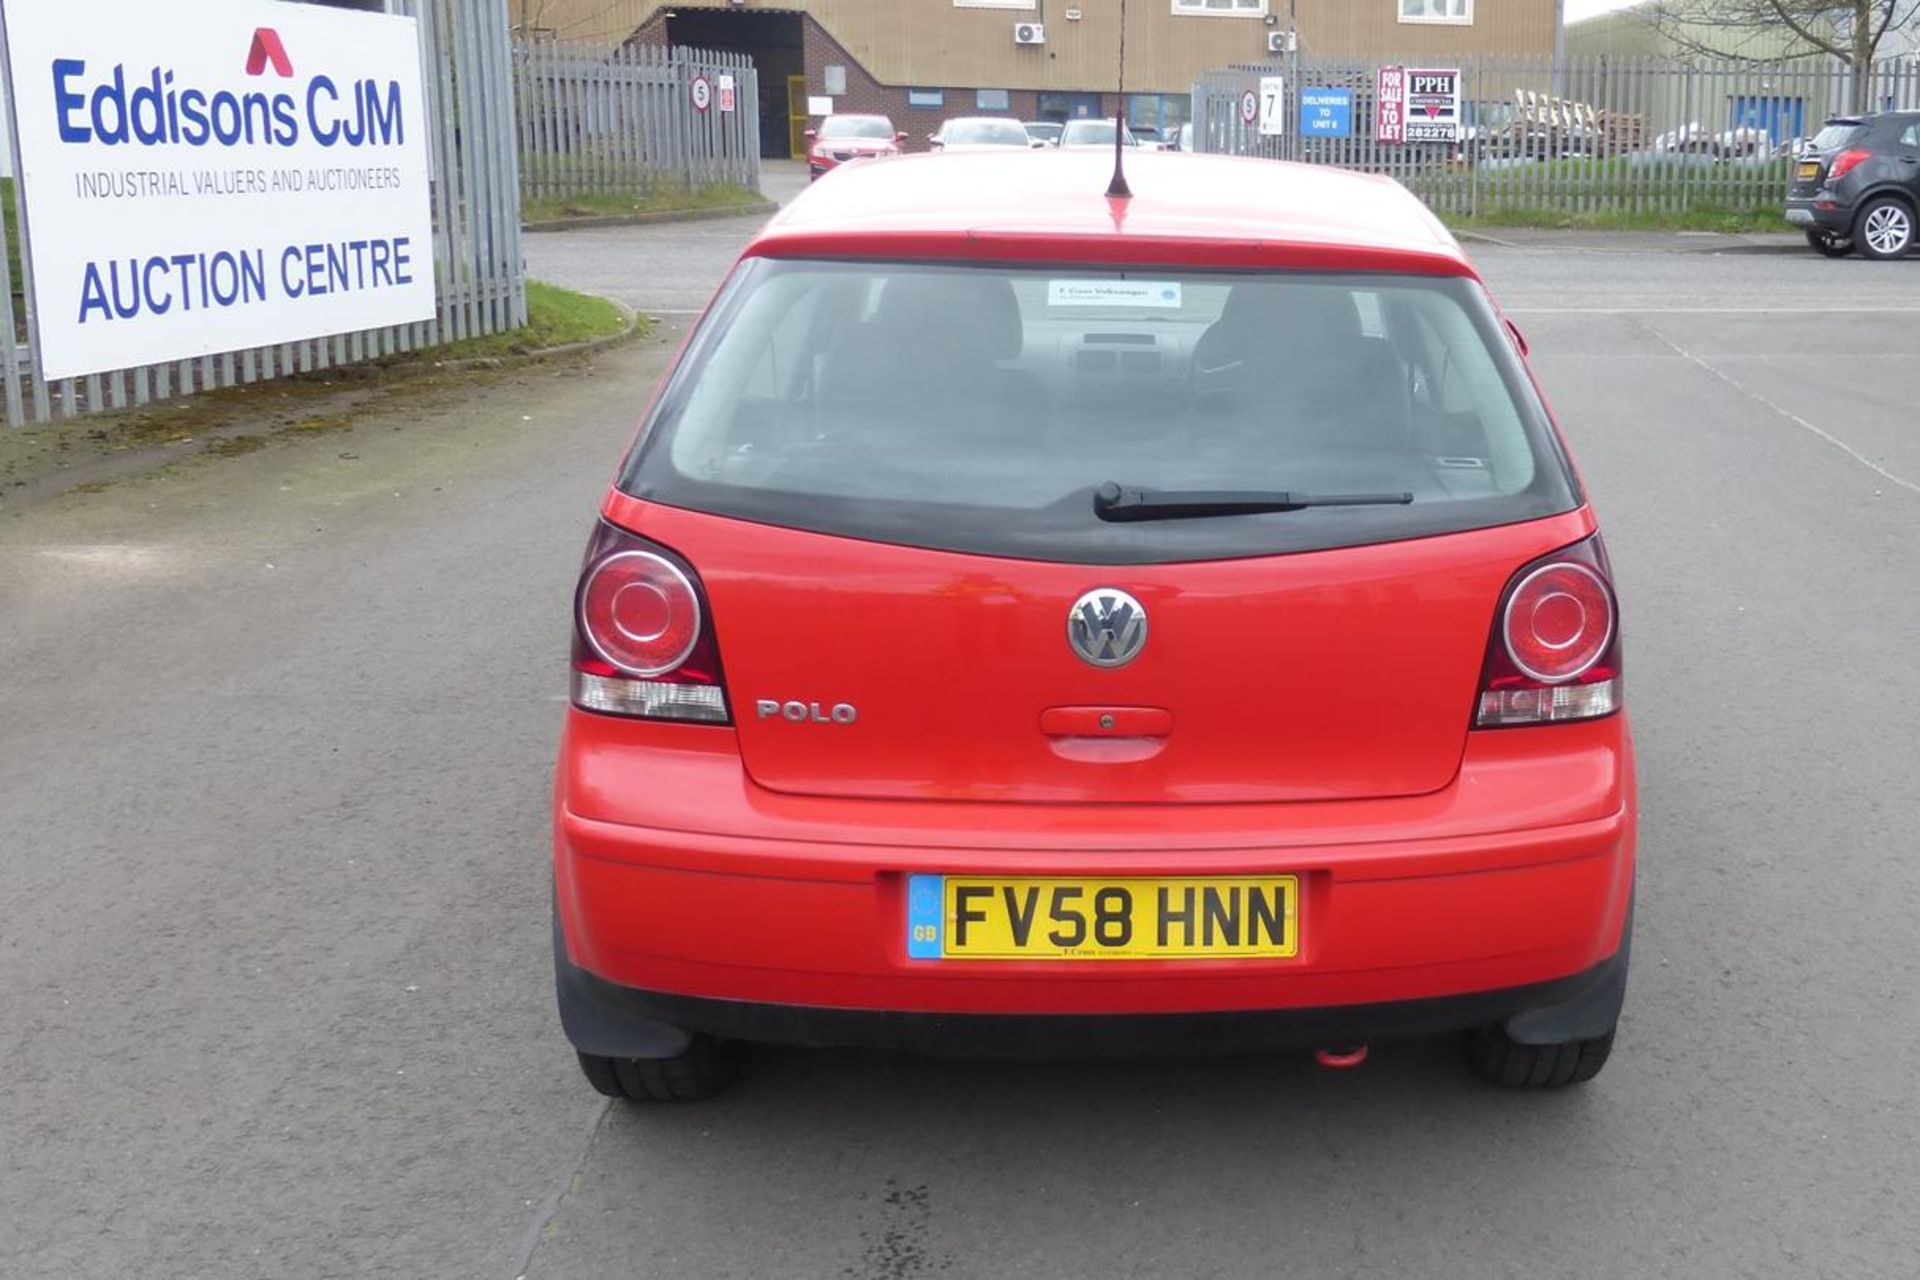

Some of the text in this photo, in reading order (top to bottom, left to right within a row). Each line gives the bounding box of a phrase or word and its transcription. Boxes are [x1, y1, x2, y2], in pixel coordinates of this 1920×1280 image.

[1382, 72, 1401, 87] FOR
[1414, 77, 1449, 92] PPH
[697, 86, 705, 101] 5
[1302, 96, 1348, 105] DELIVERIES
[1380, 88, 1402, 102] SALE
[52, 58, 404, 147] Eddisons CJM
[1246, 99, 1252, 112] 5
[1266, 94, 1275, 118] 7
[1319, 108, 1331, 116] TO
[1381, 109, 1398, 124] TO
[1312, 120, 1330, 128] UNIT
[1379, 125, 1401, 139] LET
[75, 167, 401, 198] INDUSTRIAL VALUERS AND AUCTIONEERS
[78, 237, 413, 324] AUCTION CENTRE
[757, 699, 857, 724] POLO
[954, 886, 1287, 948] FV58 HNN
[914, 925, 937, 942] GB
